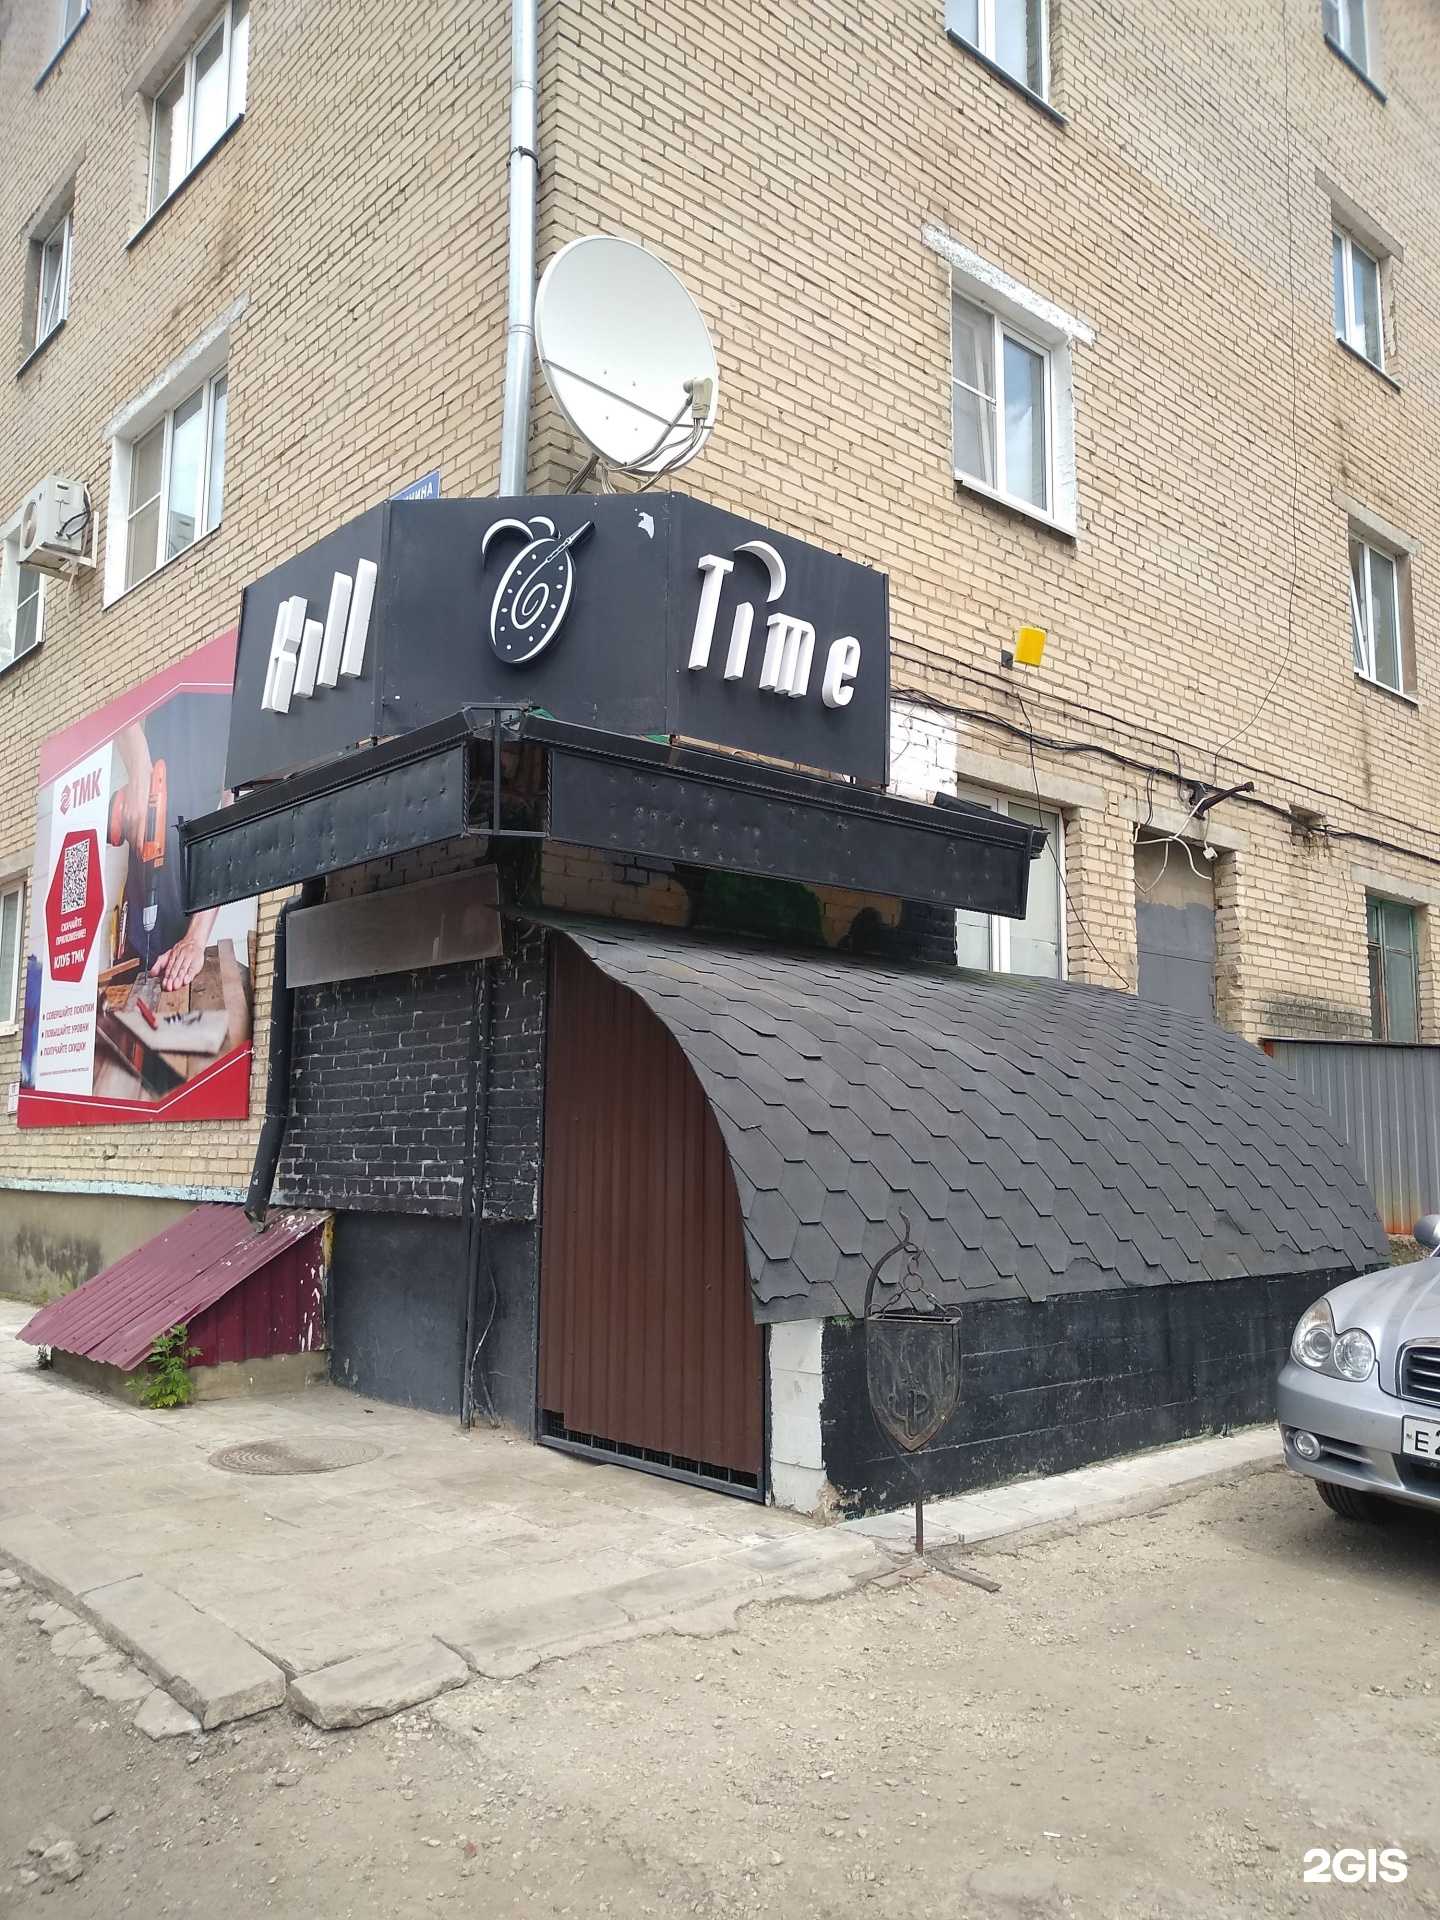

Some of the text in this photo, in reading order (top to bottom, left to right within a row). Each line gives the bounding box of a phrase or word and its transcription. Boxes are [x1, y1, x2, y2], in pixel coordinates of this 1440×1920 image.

[688, 541, 861, 709] Time
[72, 767, 103, 808] ТМК
[54, 948, 86, 970] КЛУБ ТМК
[73, 1002, 95, 1017] ПОКУПКИ
